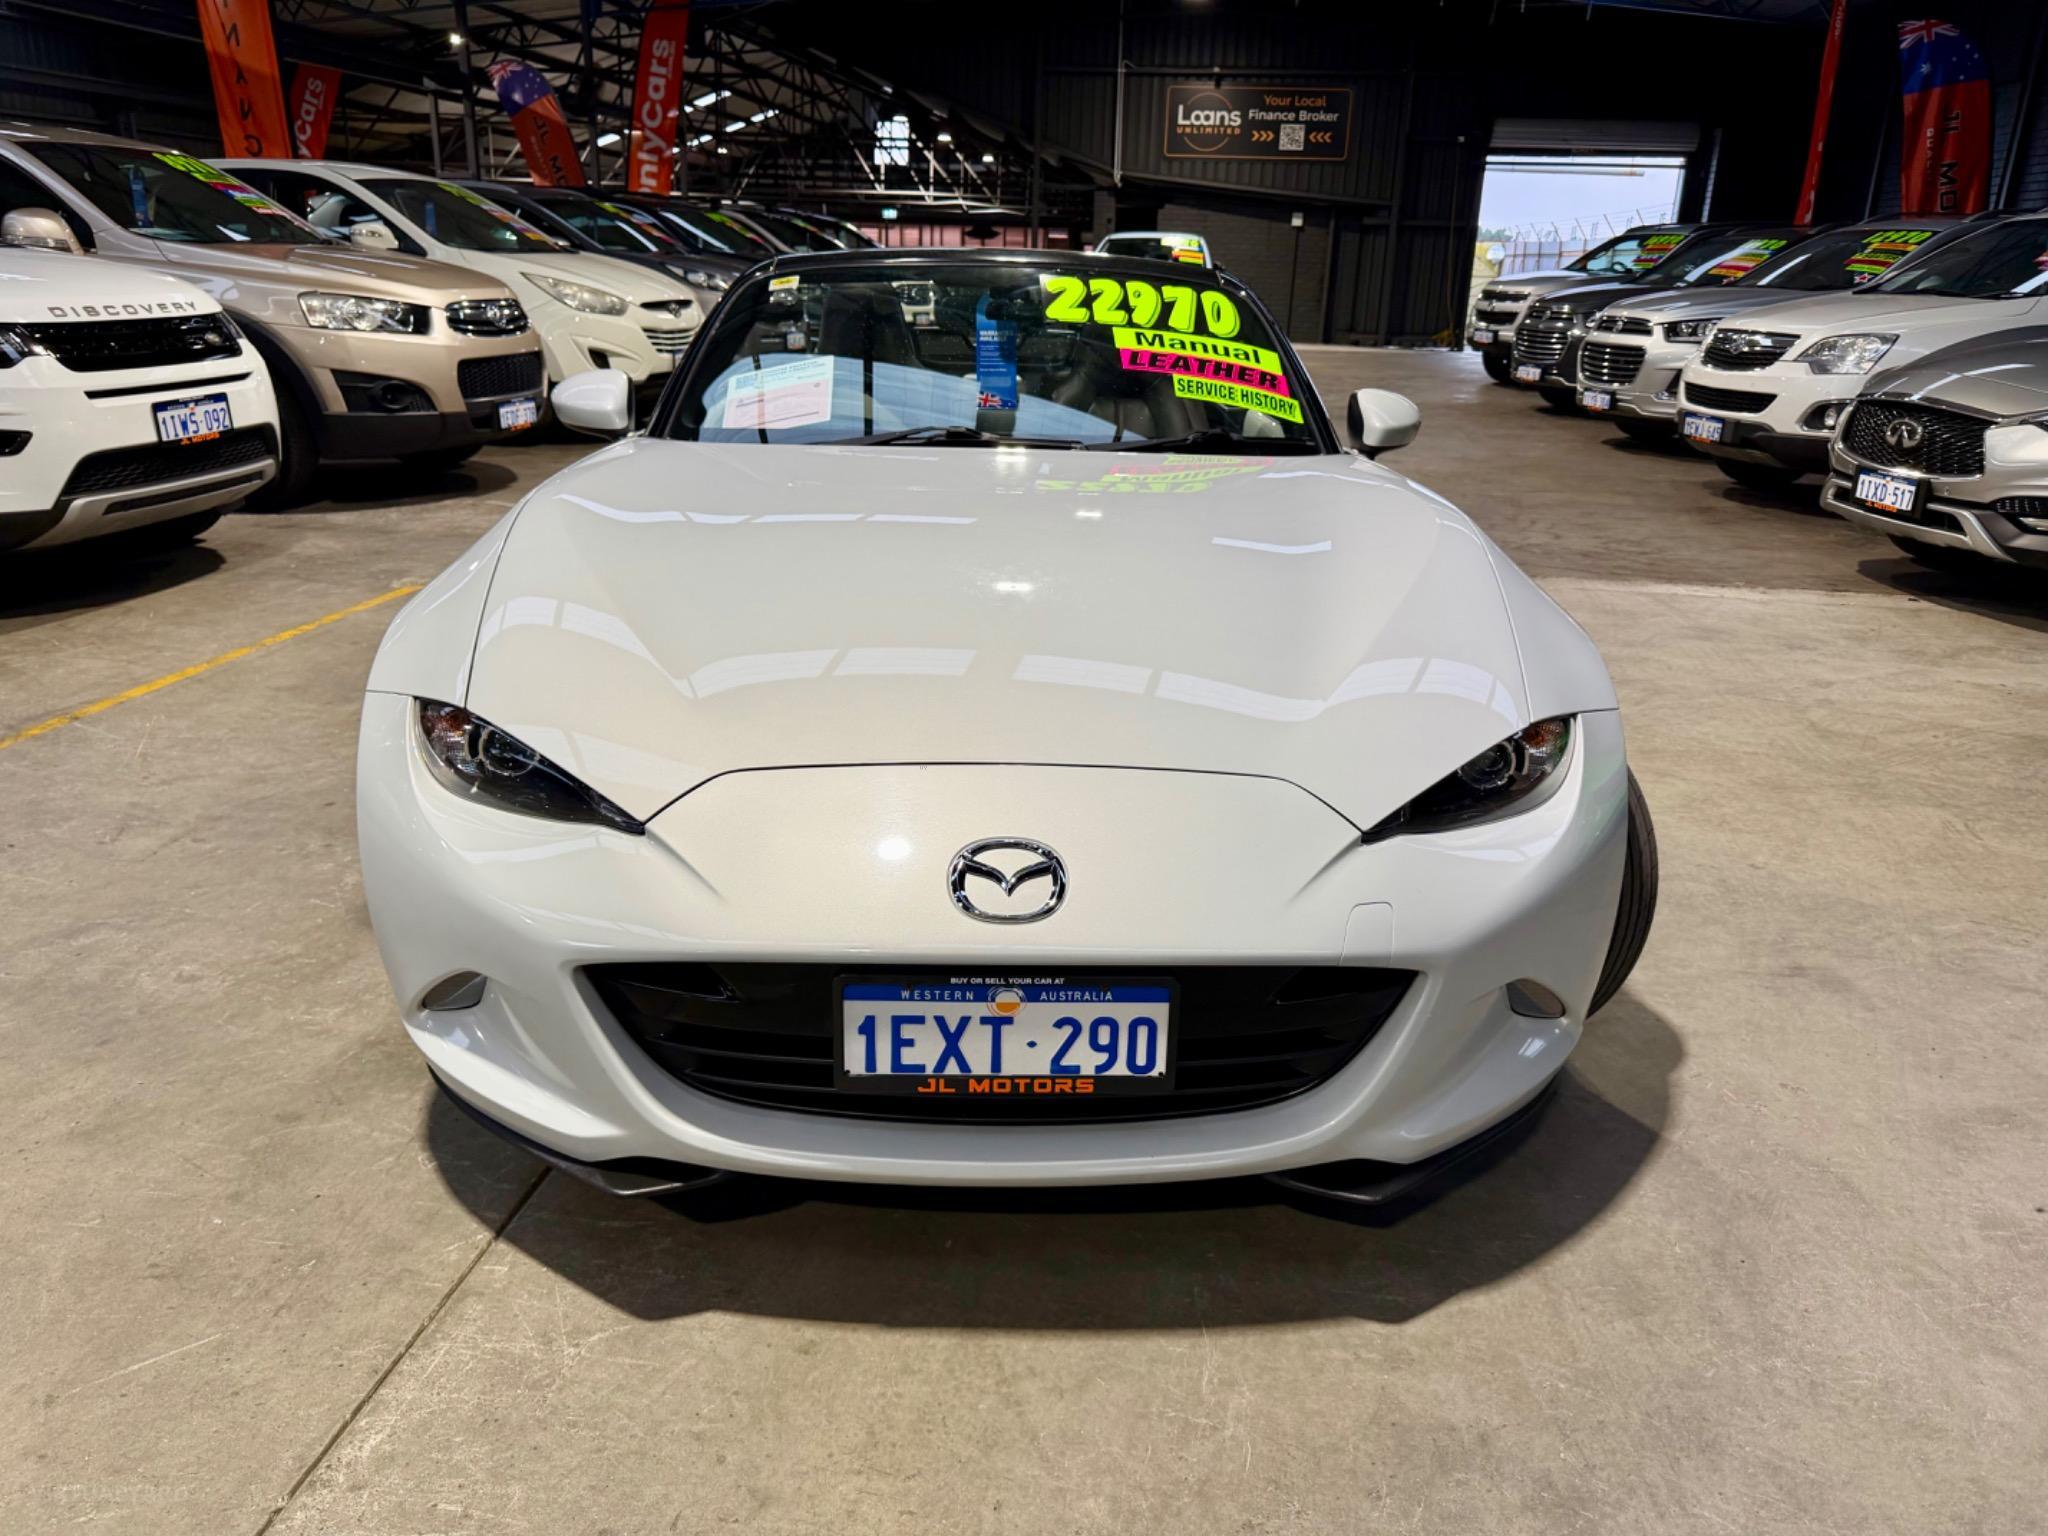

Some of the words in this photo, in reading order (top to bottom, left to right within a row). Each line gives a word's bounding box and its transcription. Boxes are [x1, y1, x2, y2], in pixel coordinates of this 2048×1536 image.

[1264, 95, 1292, 107] Your
[1295, 95, 1327, 107] Local
[1177, 104, 1242, 126] Loans
[1248, 109, 1296, 121] Finance
[1299, 110, 1340, 122] Broker
[1176, 126, 1241, 135] UNLIMITED
[48, 301, 198, 318] DISCOVERY
[1045, 276, 1241, 338] 22970
[1135, 331, 1262, 364] Manual
[1129, 350, 1280, 390] LEATHER
[1177, 379, 1236, 401] SERVICE
[1240, 387, 1296, 417] HISTORY
[900, 990, 974, 1001] WESTERN
[1039, 991, 1113, 1001] AUSTRALIA
[917, 1078, 956, 1093] JL
[968, 1078, 1096, 1094] MOTORS
